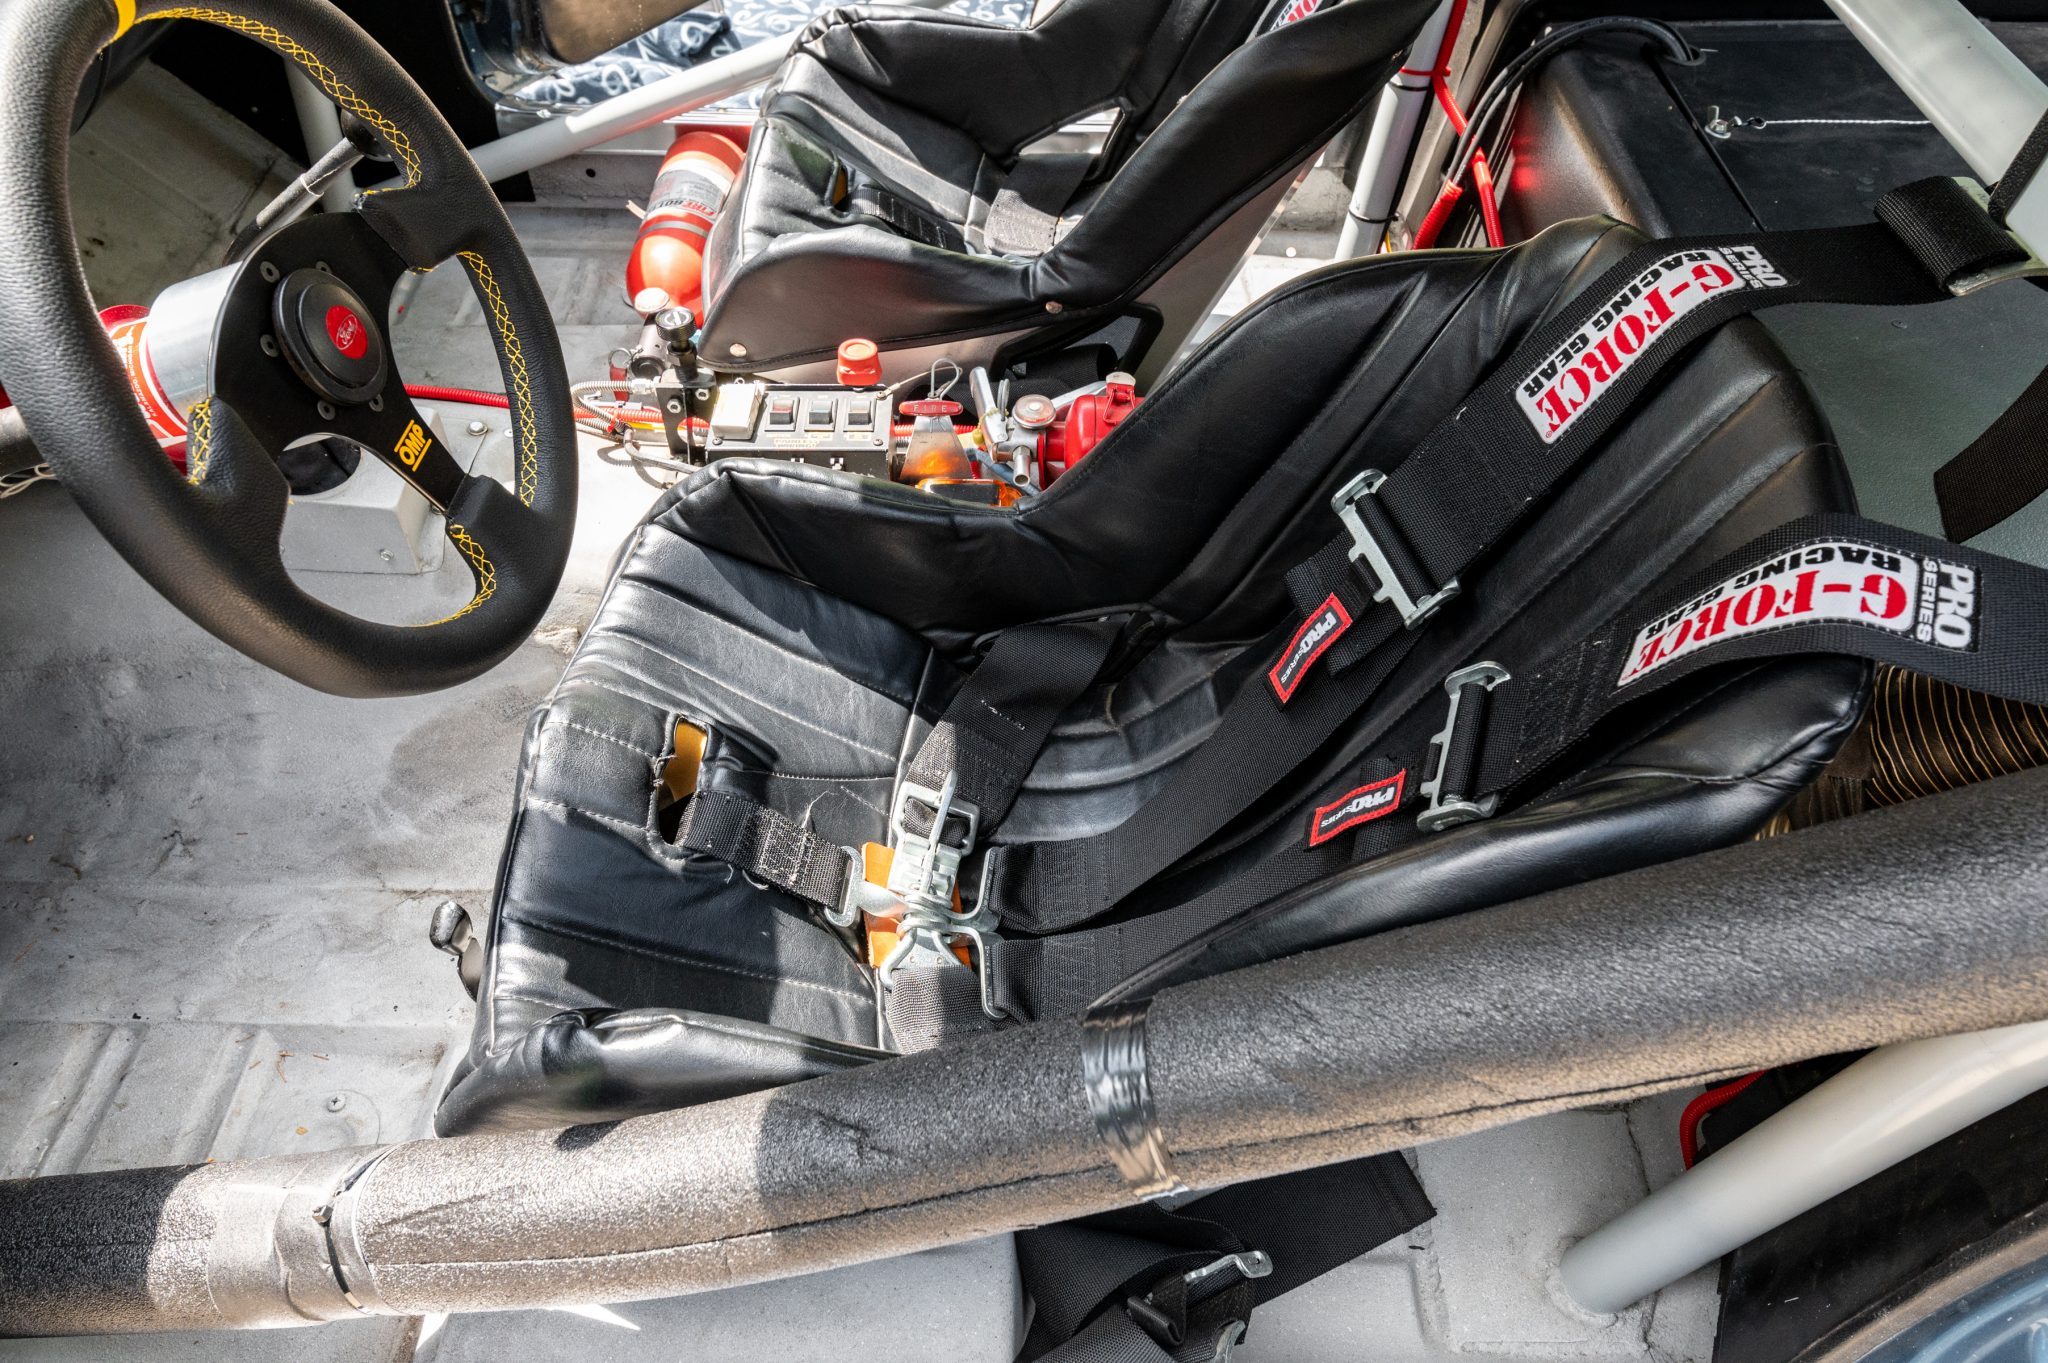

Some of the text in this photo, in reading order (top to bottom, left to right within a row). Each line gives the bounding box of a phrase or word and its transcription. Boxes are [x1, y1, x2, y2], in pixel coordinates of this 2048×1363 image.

[1718, 247, 1763, 289] SERIES
[1731, 245, 1788, 287] PRO
[1523, 251, 1711, 398] RACING GEAR
[1536, 263, 1735, 433] G-FORCE
[400, 424, 426, 465] OMP
[913, 404, 948, 413] FIRE
[1631, 570, 1907, 676] G-FORCE
[1646, 546, 1902, 640] RACING GEAR
[1915, 558, 1939, 642] SERIES
[1934, 561, 1976, 649] PRO
